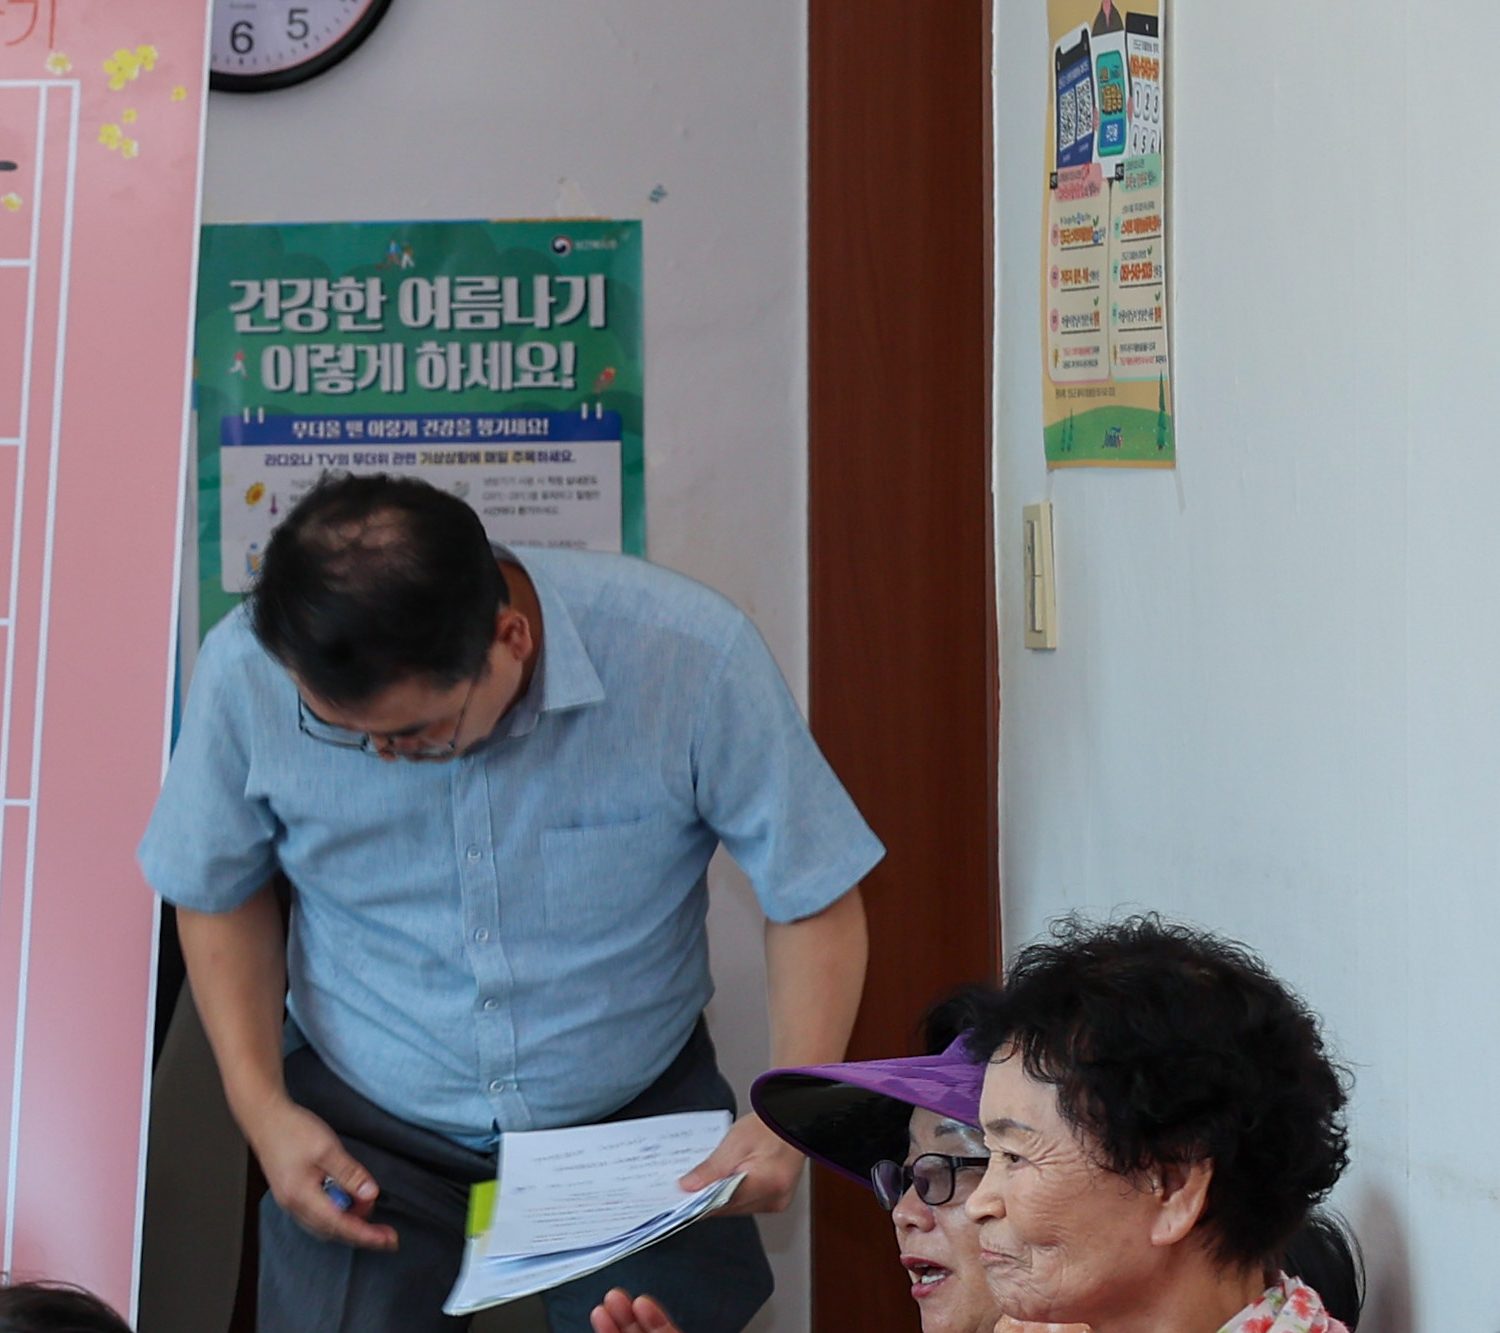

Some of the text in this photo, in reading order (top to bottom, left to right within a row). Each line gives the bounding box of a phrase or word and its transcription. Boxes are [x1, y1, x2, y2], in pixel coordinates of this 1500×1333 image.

[230, 8, 309, 54] 6 5
[228, 274, 607, 334] 건강한 여름나기
[260, 341, 578, 395] 이렇게 하세요!
